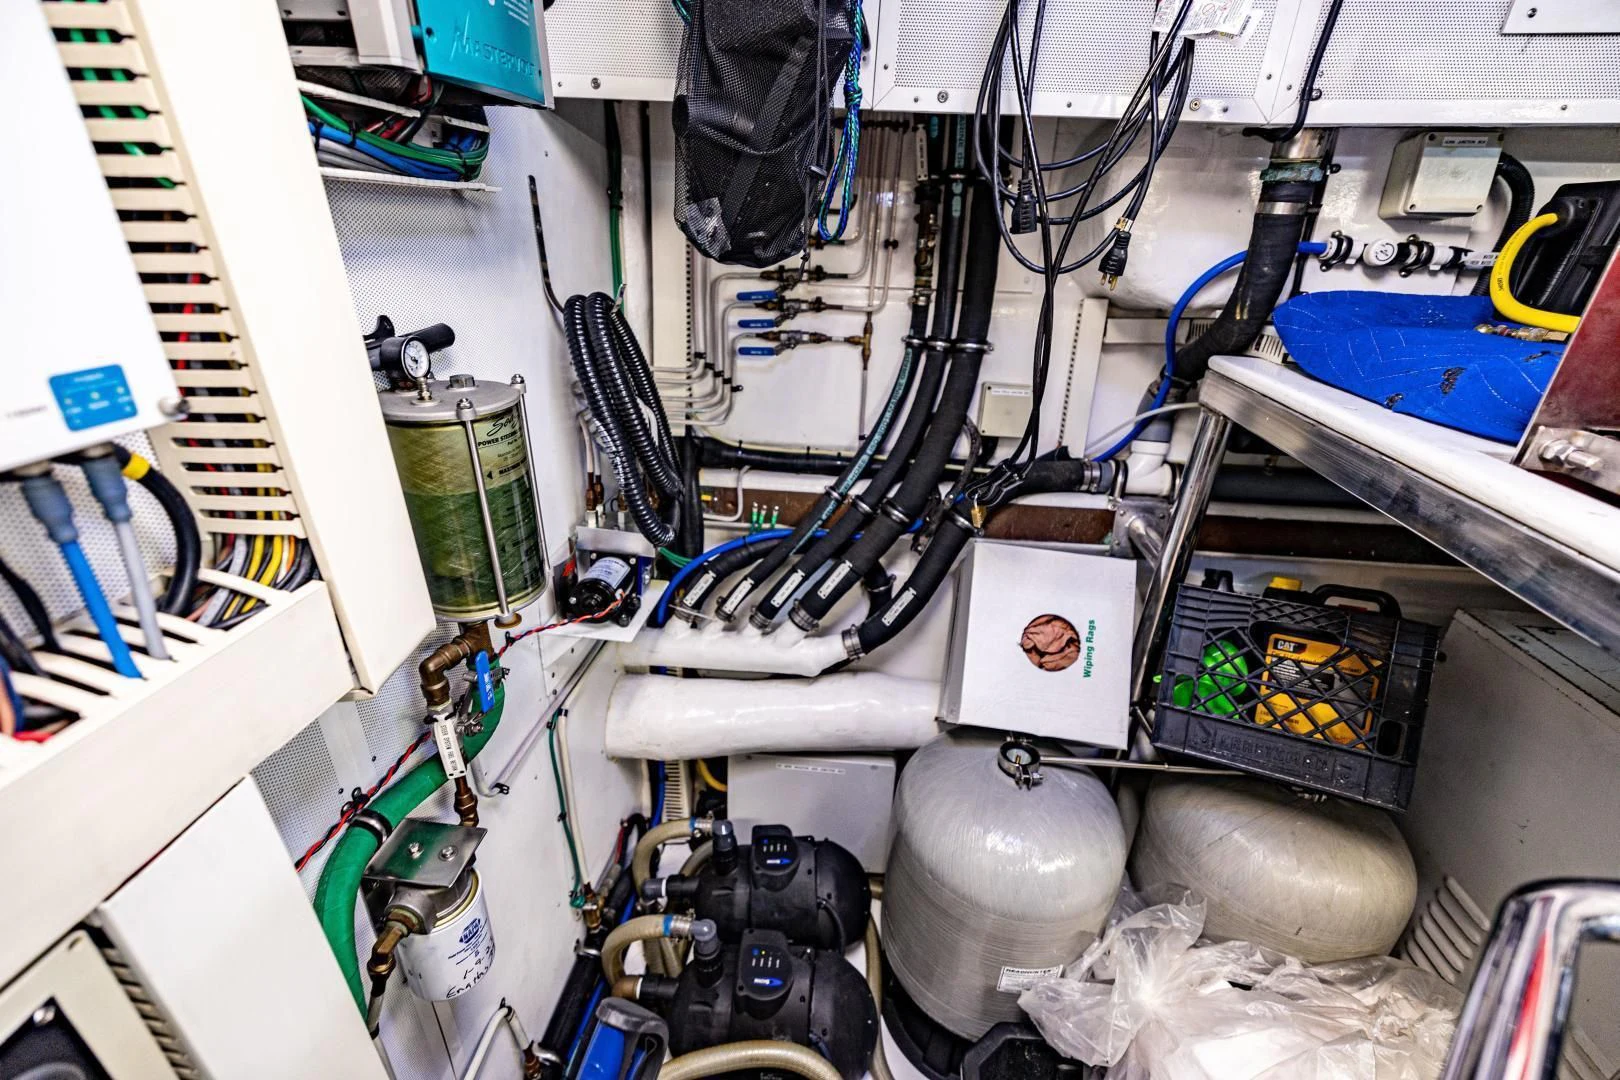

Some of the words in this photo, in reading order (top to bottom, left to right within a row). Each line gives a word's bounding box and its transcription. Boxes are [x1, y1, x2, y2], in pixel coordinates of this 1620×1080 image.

[449, 12, 535, 80] MASTERVOLT
[478, 438, 500, 447] POWER
[1086, 619, 1097, 643] Rags
[1277, 640, 1297, 652] CAT
[1083, 646, 1095, 678] Wiping
